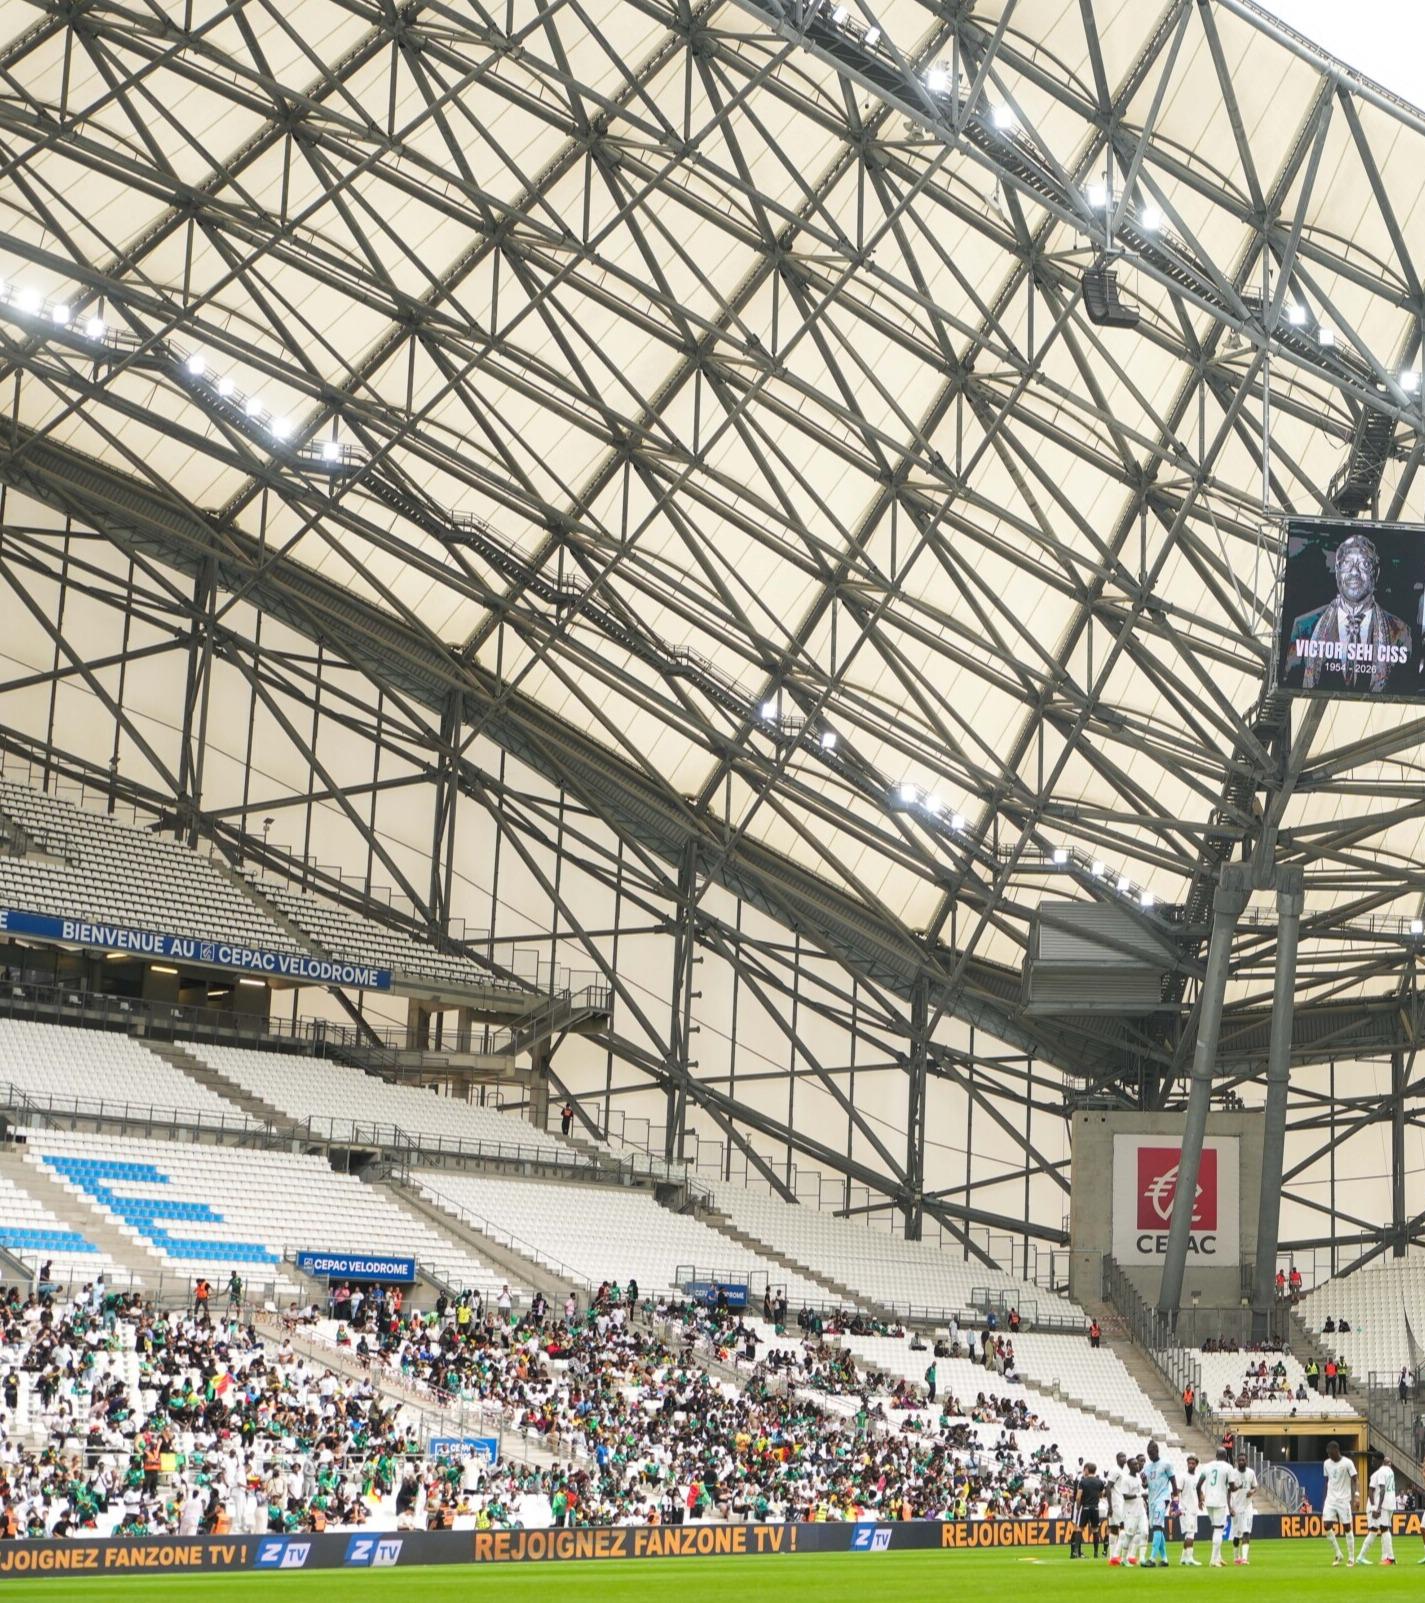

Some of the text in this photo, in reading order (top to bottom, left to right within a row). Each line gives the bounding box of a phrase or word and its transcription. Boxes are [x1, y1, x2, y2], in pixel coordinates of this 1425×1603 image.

[1295, 639, 1408, 664] VICTOR SEH CISS
[1325, 662, 1346, 672] 1954
[62, 921, 378, 986] BIENVENUE AU CEPAC VELODROME
[1136, 1235, 1216, 1254] CEAC
[314, 1259, 408, 1275] CEPAC VELODROME
[1211, 1469, 1218, 1486] 3
[475, 1531, 626, 1561] REJOIGNEZ
[635, 1526, 746, 1556] FANZONE
[754, 1526, 784, 1552] TV
[942, 1521, 1050, 1547] REJOIGNEZ
[0, 1549, 99, 1571] JOIGNEZ
[105, 1547, 202, 1566] FANZONE
[209, 1545, 235, 1564] TV
